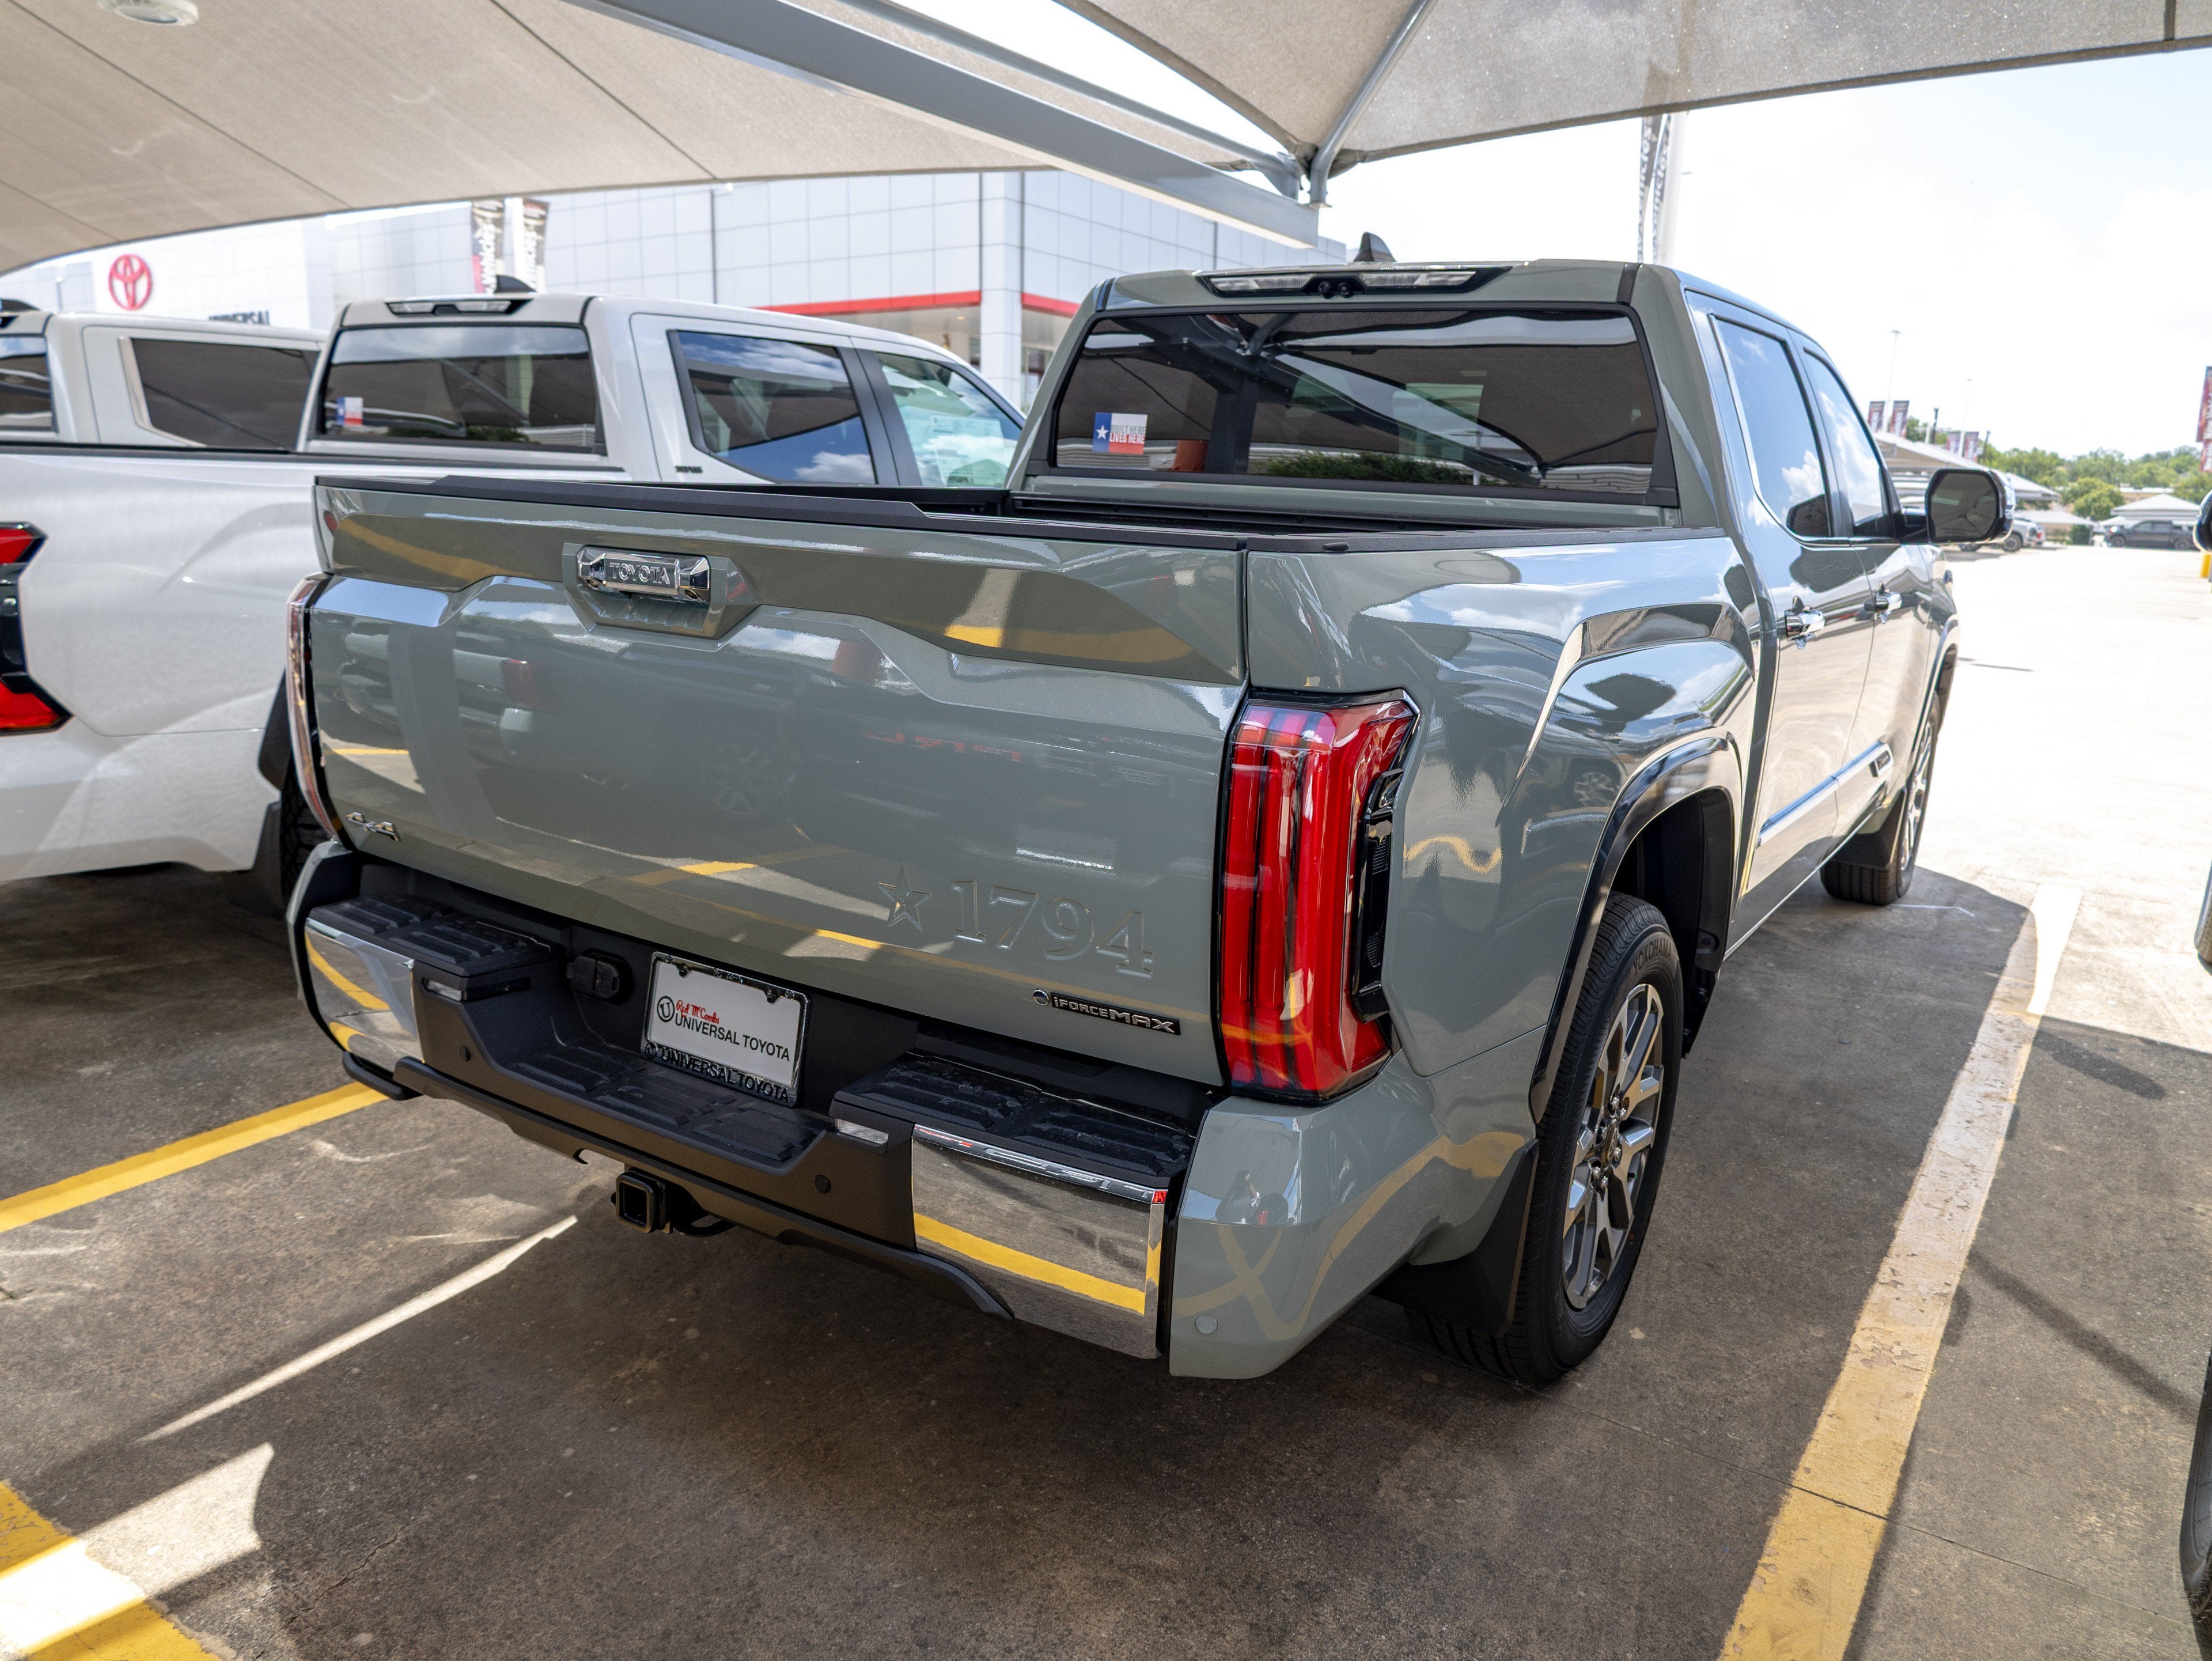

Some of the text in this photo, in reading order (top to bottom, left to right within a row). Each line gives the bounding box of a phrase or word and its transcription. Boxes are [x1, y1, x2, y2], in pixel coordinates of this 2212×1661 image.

[1111, 425, 1146, 434] BUILT HERE
[1128, 434, 1145, 444] HERE
[609, 562, 671, 585] TOYOTA
[952, 880, 1153, 978] 1794
[1633, 938, 1671, 977] YOKOHAMA
[676, 1000, 719, 1024] Red McCombs
[675, 1013, 790, 1061] UNIVERSAL TOYOTA
[662, 1047, 790, 1102] UNIVERSAL TOYOTA
